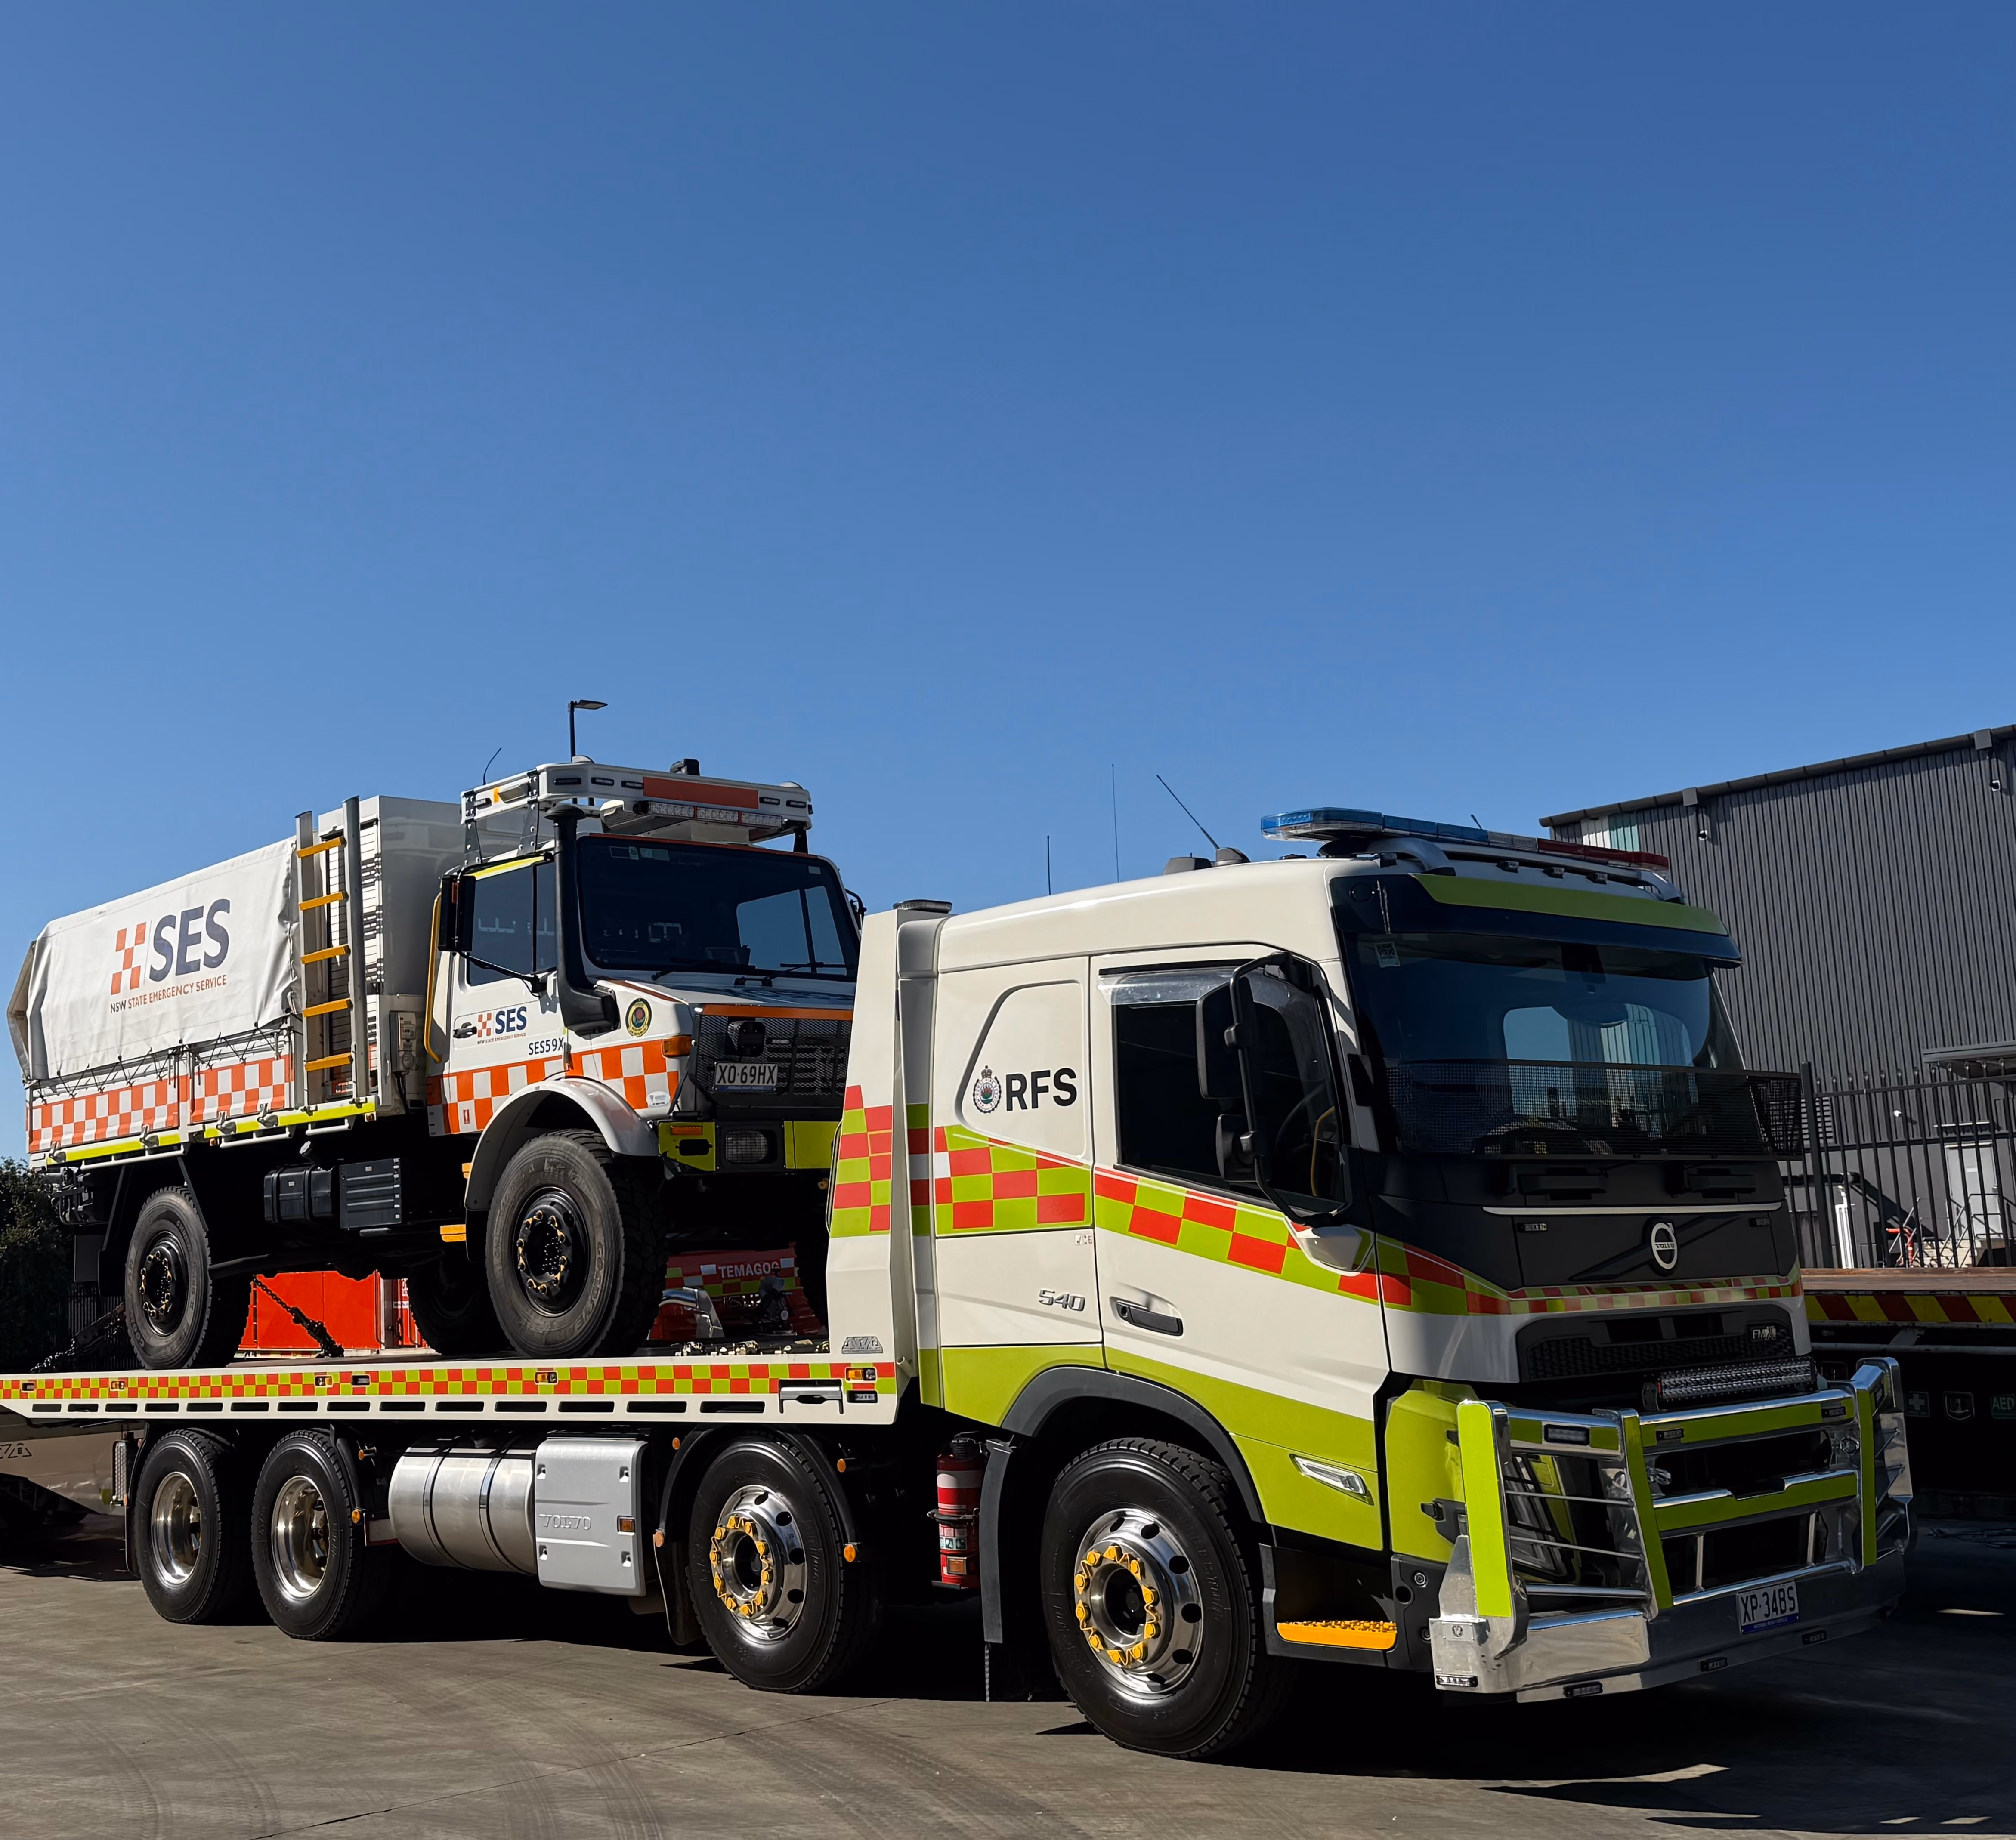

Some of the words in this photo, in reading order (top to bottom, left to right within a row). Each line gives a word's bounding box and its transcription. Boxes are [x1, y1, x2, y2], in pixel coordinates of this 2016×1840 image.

[149, 898, 230, 982] SES
[111, 1000, 126, 1013] NSW
[128, 994, 147, 1009] STATE
[149, 982, 194, 1003] EMERGENCY
[196, 975, 226, 992] SERVICE
[495, 1006, 526, 1034] SES
[529, 1037, 564, 1055] SES59X
[1006, 1068, 1077, 1111] RFS
[1039, 1289, 1085, 1311] 540
[1992, 1396, 2015, 1410] AED
[538, 1513, 591, 1530] VOLVO
